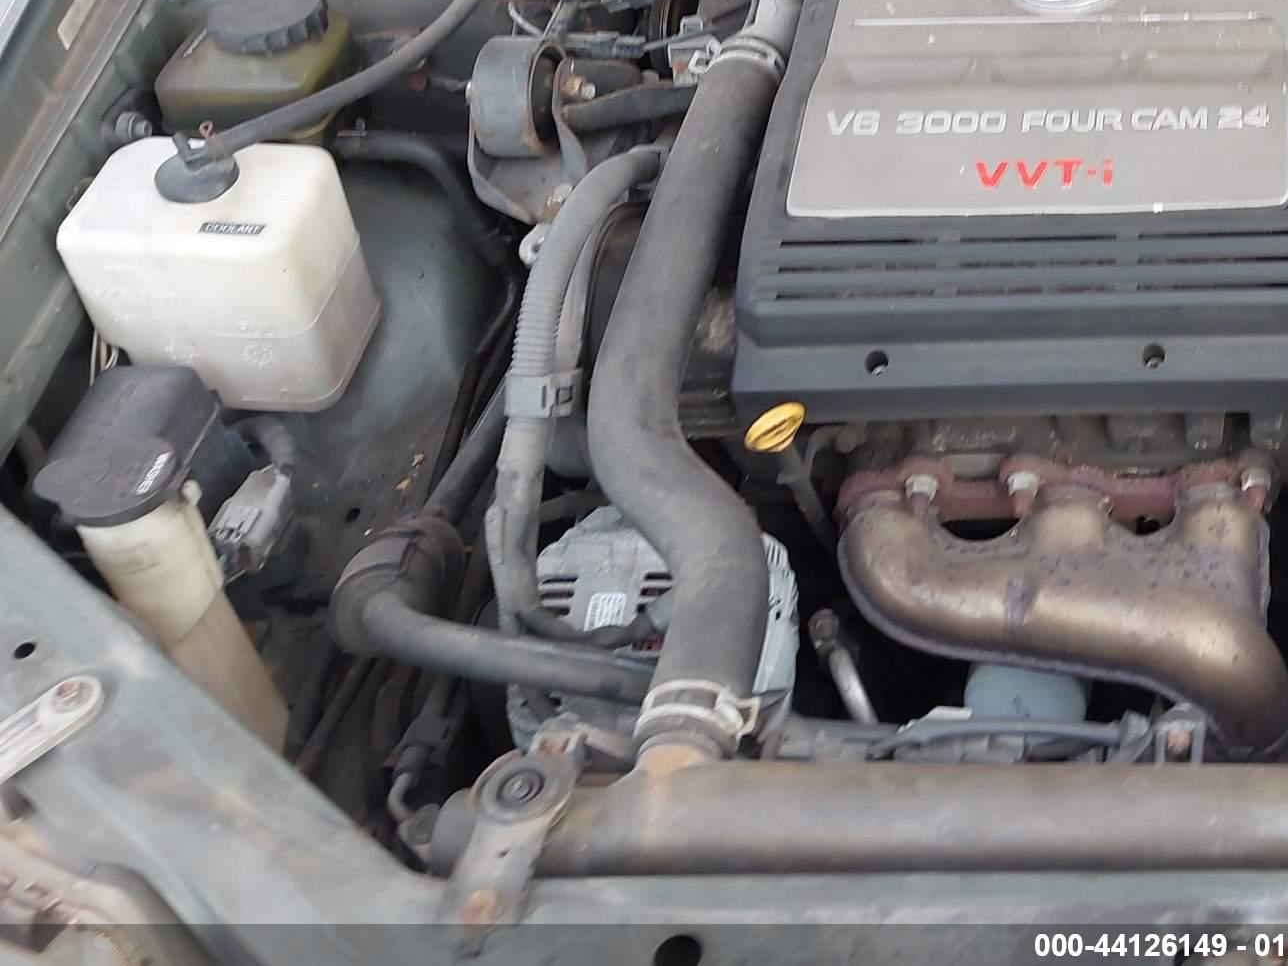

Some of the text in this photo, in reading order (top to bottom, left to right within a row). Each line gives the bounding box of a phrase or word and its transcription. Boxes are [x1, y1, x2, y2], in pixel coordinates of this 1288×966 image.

[826, 107, 1270, 135] V6 3000 FOUR CAM 24
[975, 161, 1115, 190] VVT-i
[204, 223, 259, 234] COOLANT
